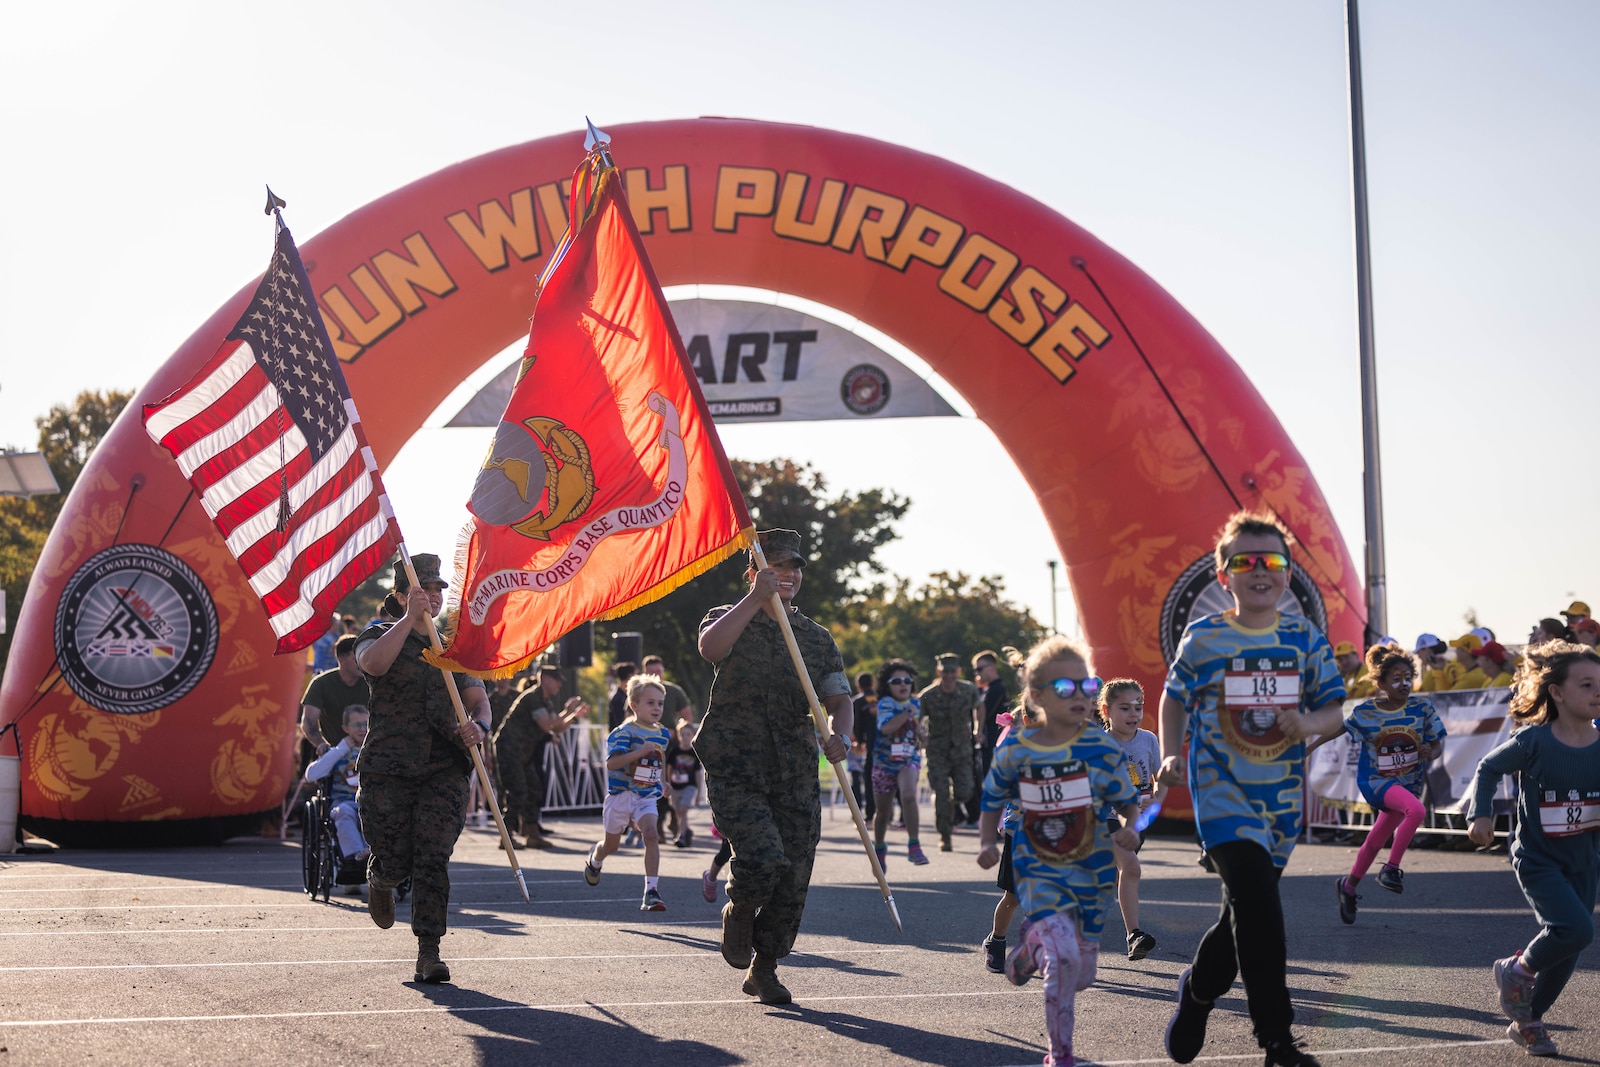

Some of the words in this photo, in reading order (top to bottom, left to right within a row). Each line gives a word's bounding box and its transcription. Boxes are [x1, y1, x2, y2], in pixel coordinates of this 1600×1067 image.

[444, 164, 693, 273] WIH
[712, 165, 1113, 386] PURPOSE
[535, 552, 582, 587] CORPS
[575, 516, 613, 552] BASE
[617, 481, 681, 527] QUANTICO
[94, 557, 131, 578] ALWAYS
[132, 557, 173, 578] EARNED
[95, 683, 128, 700] NEVER
[130, 683, 165, 700] GIVEN
[1252, 676, 1277, 697] 143
[1391, 754, 1406, 766] 103
[1039, 783, 1064, 804] 118
[1566, 806, 1582, 824] 82
